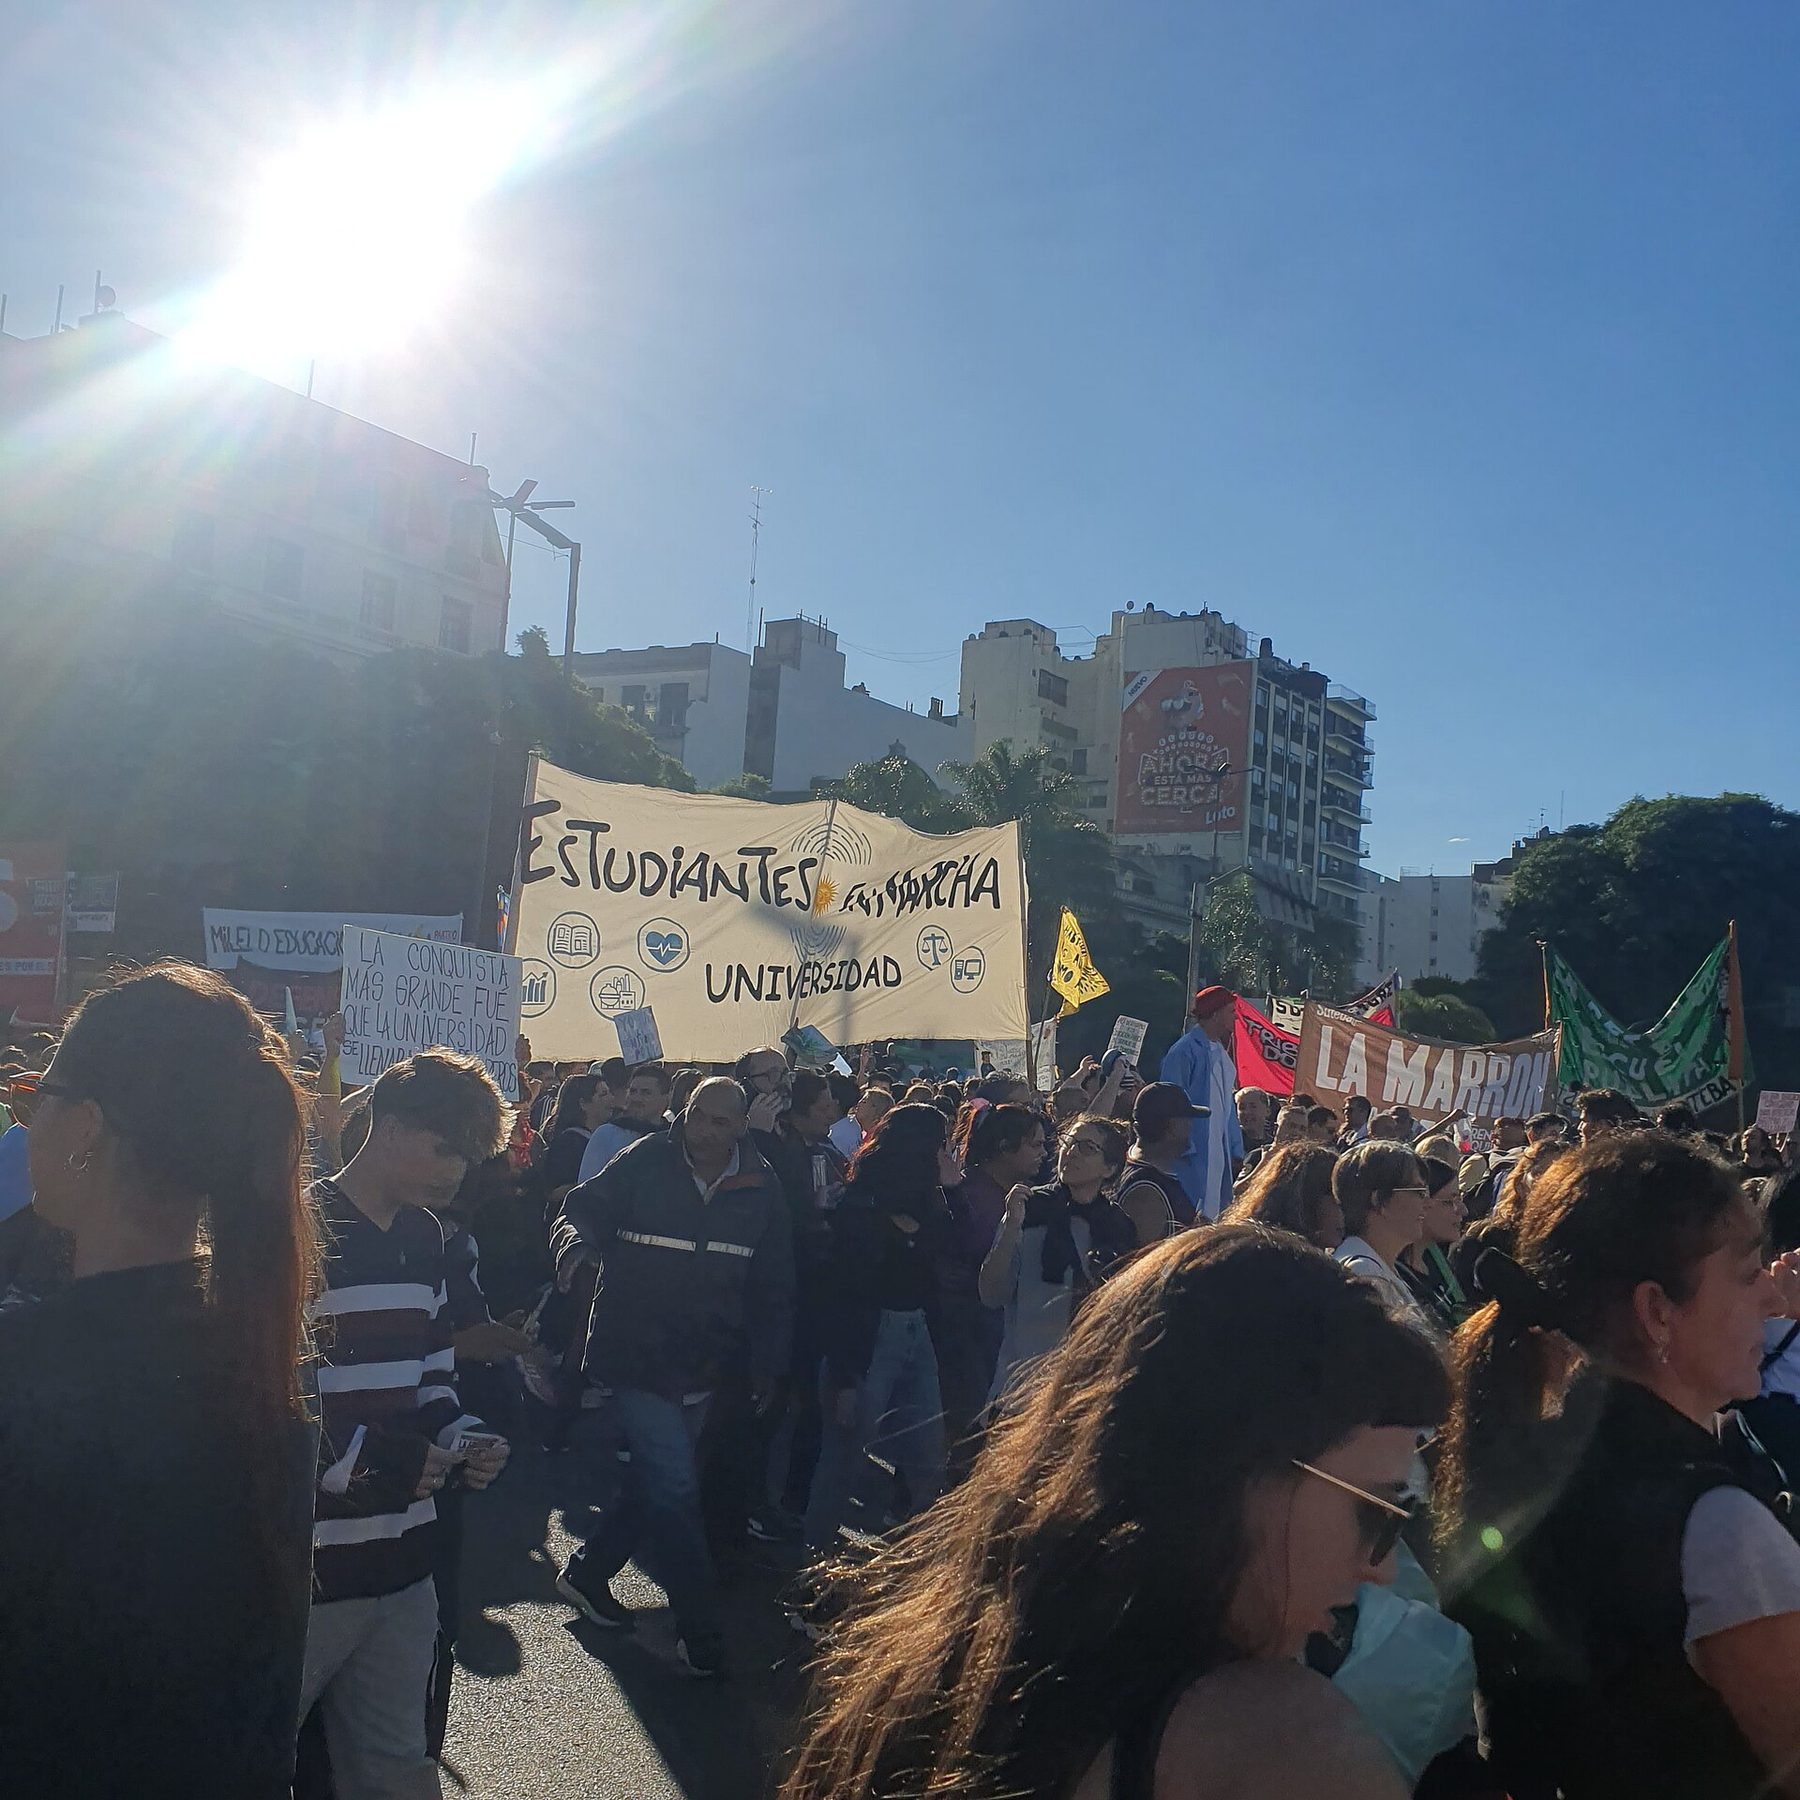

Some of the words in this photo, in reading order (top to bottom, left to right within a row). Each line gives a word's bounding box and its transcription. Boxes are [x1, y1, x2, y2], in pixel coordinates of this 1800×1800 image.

[1128, 676, 1148, 696] NUEVO
[1141, 784, 1222, 805] CERCA
[360, 932, 384, 966] LA
[407, 943, 508, 986] CONQUISTA
[706, 955, 902, 1003] UNIVERSIDAD
[345, 964, 384, 1001] MÁS
[395, 975, 464, 1014] GRANDE
[473, 986, 509, 1022] FUÉ
[343, 1004, 372, 1037] QUE
[376, 1003, 390, 1040] LA
[342, 1040, 359, 1055] SE
[1315, 1025, 1368, 1097] LA
